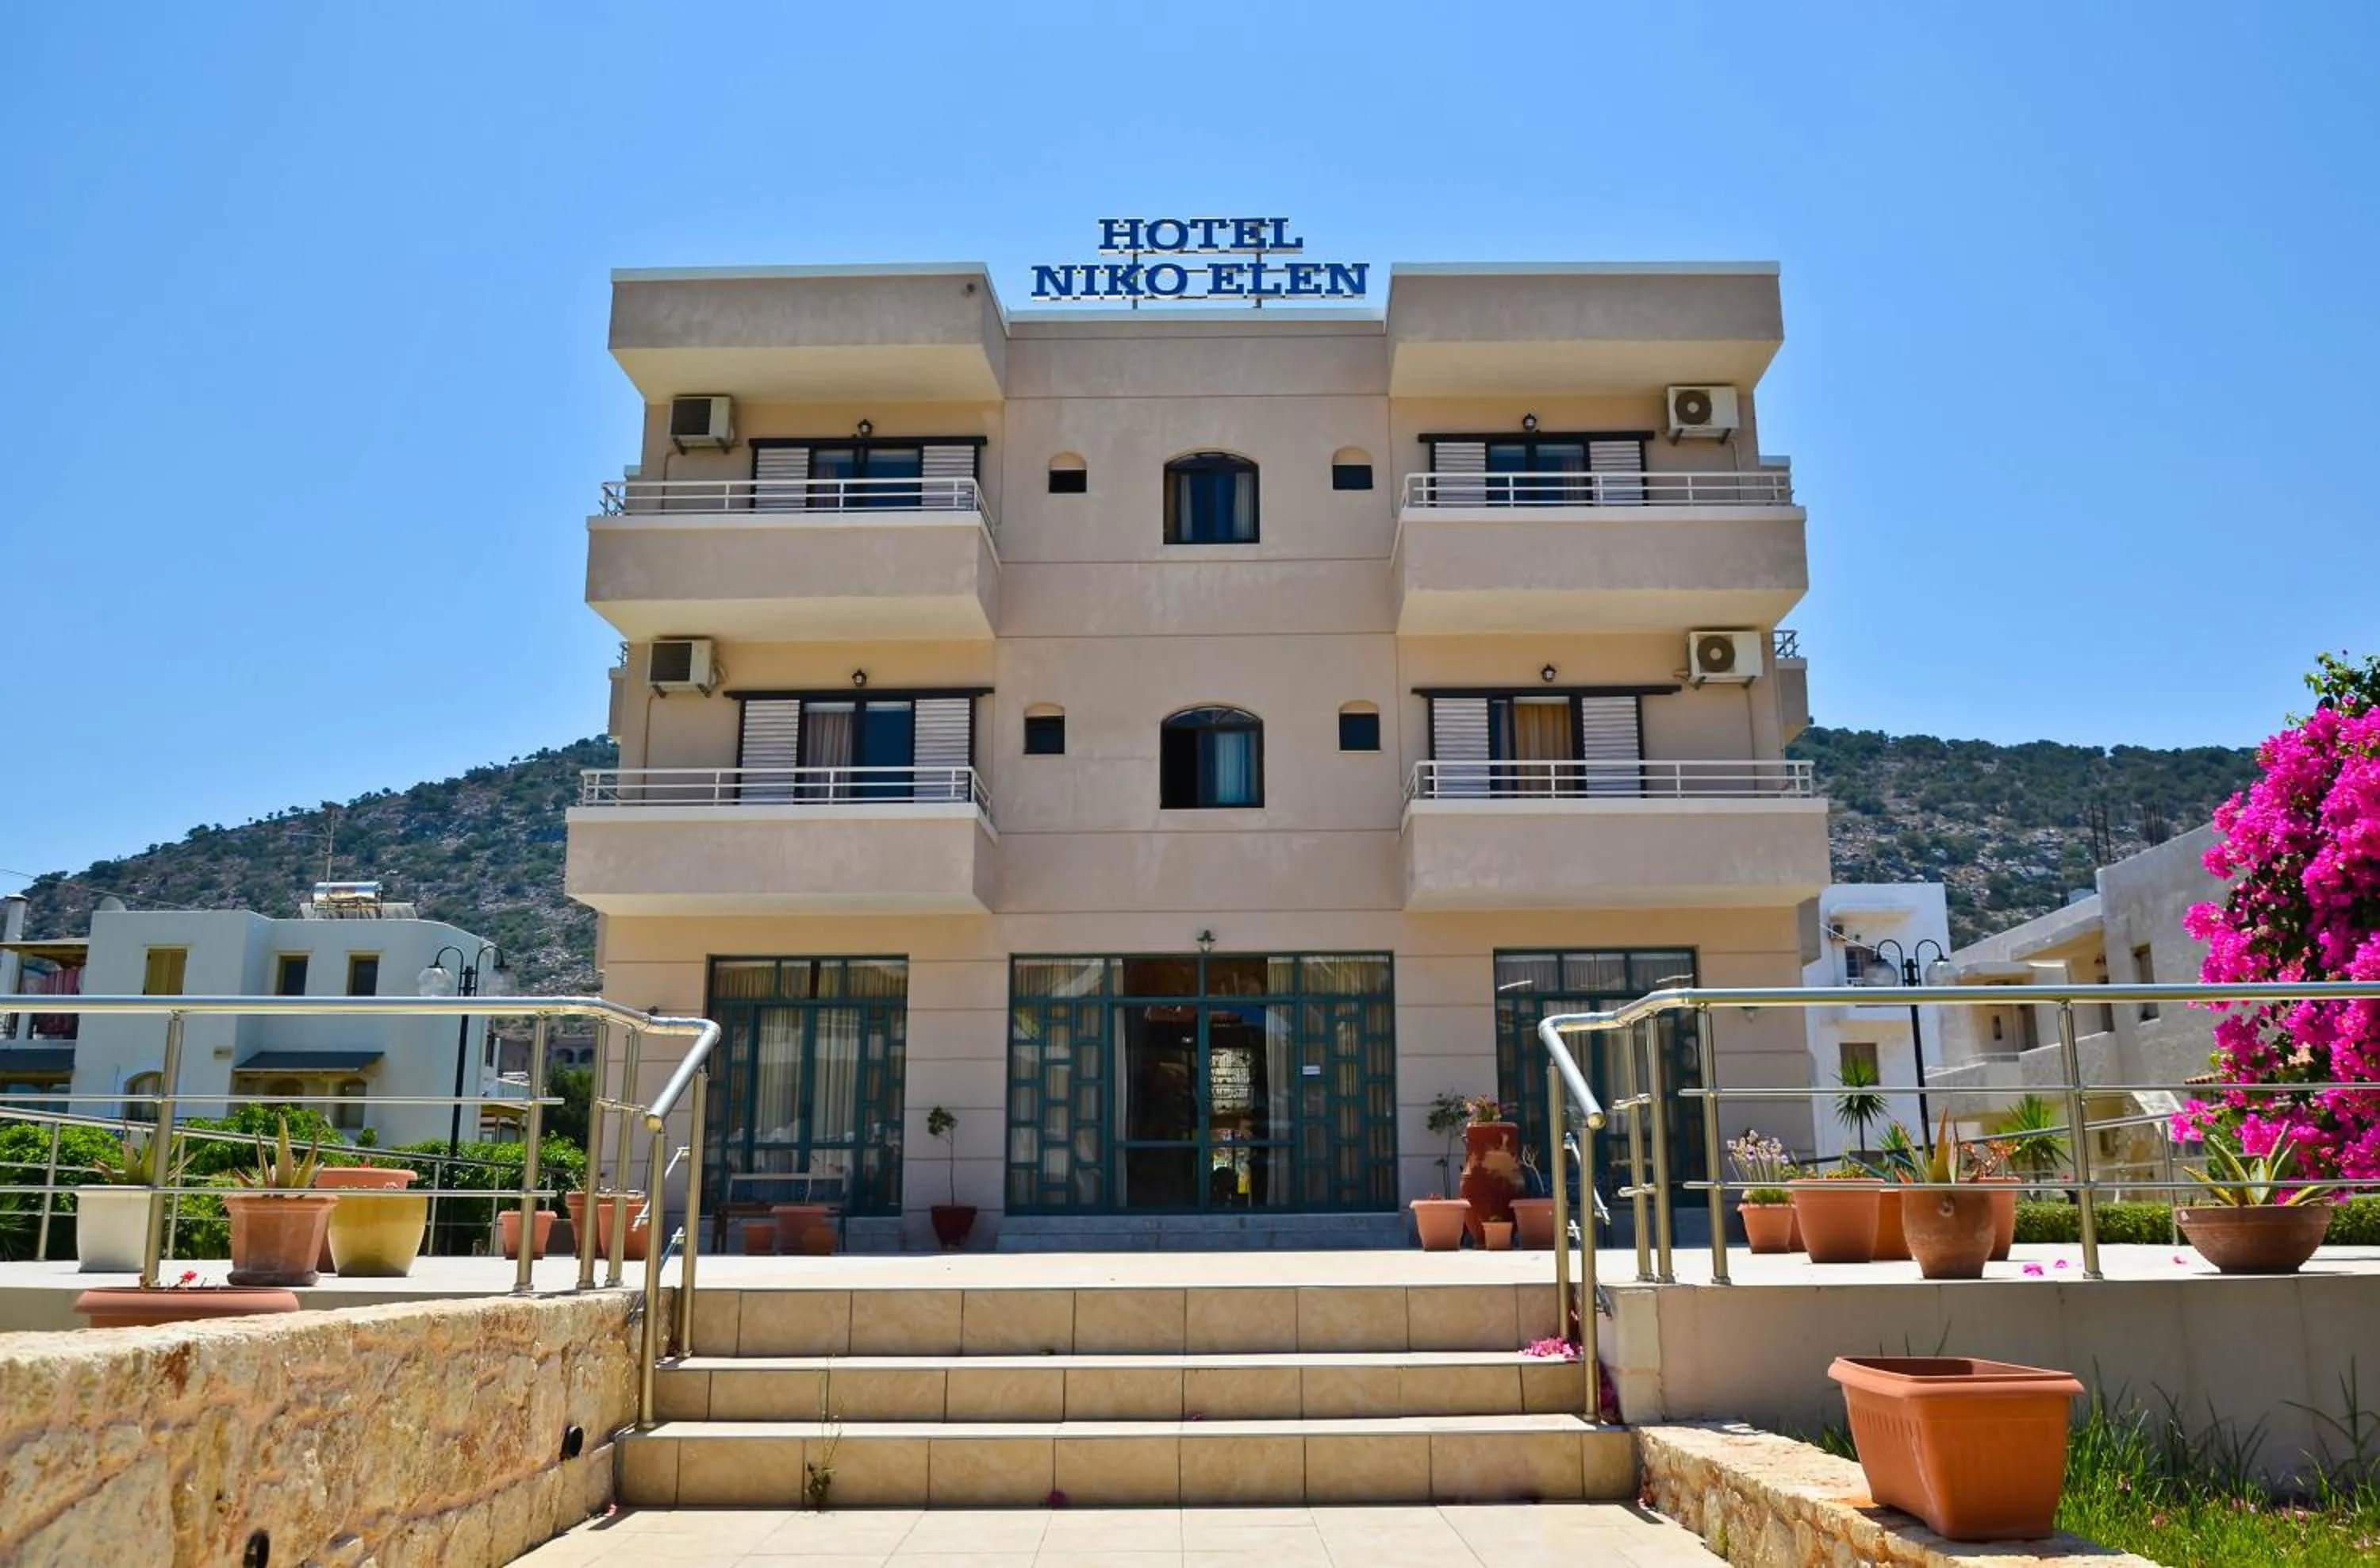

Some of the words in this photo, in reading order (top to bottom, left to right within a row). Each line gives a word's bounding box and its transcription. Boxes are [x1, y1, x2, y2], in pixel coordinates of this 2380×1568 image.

[1099, 217, 1303, 251] HOTEL
[1031, 263, 1188, 297] NIKO
[1207, 263, 1370, 295] ELEN
